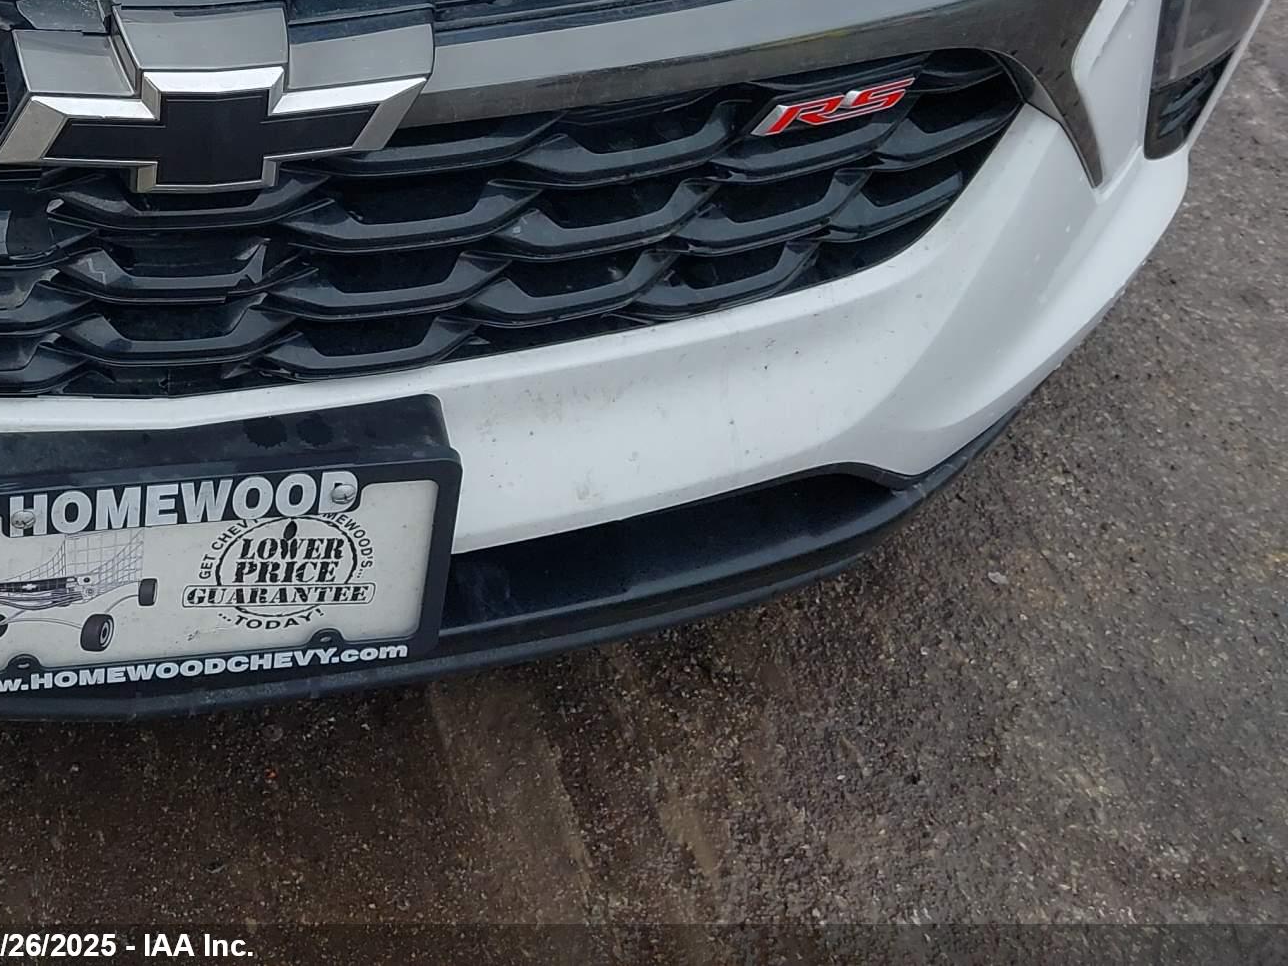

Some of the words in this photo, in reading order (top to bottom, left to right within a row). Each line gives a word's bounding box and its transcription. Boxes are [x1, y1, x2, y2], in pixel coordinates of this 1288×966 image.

[750, 77, 916, 136] RS
[9, 471, 358, 537] HOMEWOOD
[198, 554, 216, 580] GET
[211, 519, 258, 550] CHEV
[238, 538, 345, 560] LOWER
[232, 561, 340, 583] PRICE
[187, 586, 369, 605] GUARANTEE
